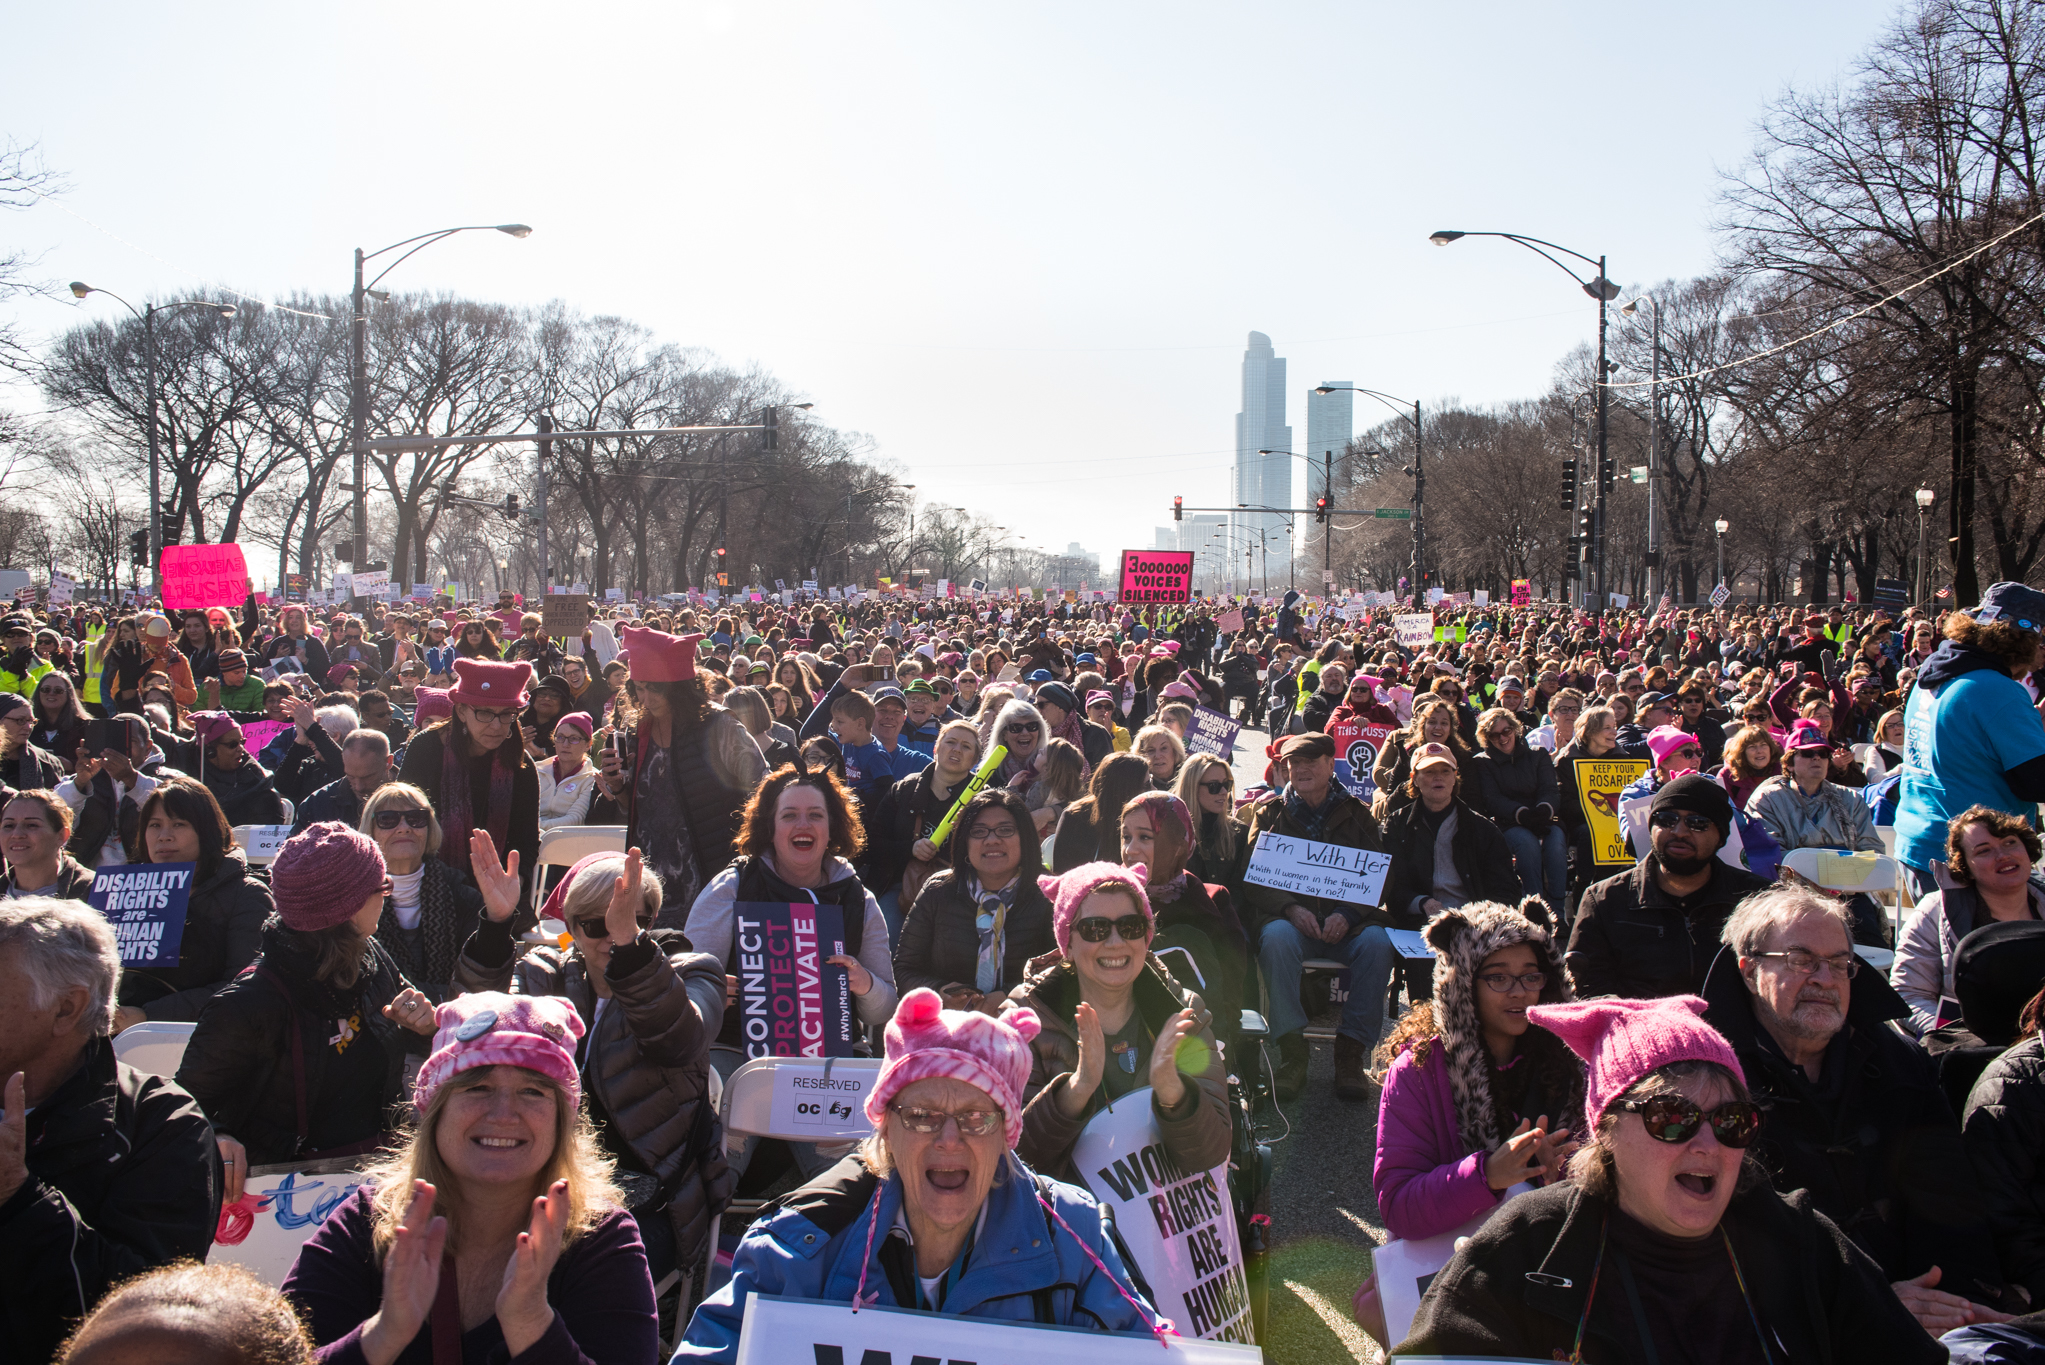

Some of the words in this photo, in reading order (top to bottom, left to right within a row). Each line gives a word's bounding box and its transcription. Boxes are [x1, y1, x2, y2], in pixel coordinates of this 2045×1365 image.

[369, 578, 389, 588] LOVE
[1134, 575, 1182, 588] VOICES
[163, 579, 246, 604] RESPECT
[1124, 589, 1185, 601] SILENCED
[555, 602, 579, 611] FREE
[545, 618, 584, 627] OPPRESSED
[1397, 615, 1430, 626] AMERICA
[1396, 628, 1435, 643] RAINBOW
[1193, 708, 1240, 732] DISABILITY
[1197, 719, 1229, 738] RIGHTS
[242, 721, 270, 739] ands
[1204, 731, 1217, 740] are
[1337, 725, 1359, 736] THIS
[1361, 726, 1391, 739] PUSSY
[1191, 732, 1224, 752] HUMAN
[1593, 764, 1610, 774] KEEP
[1614, 764, 1636, 774] YOUR
[1257, 833, 1294, 856] I'm
[1307, 842, 1346, 867] With
[1354, 851, 1390, 874] Her
[94, 870, 191, 893] DISABILITY
[1247, 872, 1266, 884] how
[1267, 877, 1293, 889] could
[1305, 885, 1321, 896] say
[1281, 871, 1309, 881] women
[1312, 875, 1321, 883] in
[1323, 875, 1338, 886] the
[105, 889, 170, 911] RIGHTS
[121, 910, 147, 922] are
[114, 921, 166, 942] UMAN
[738, 915, 770, 1061] CONNECT
[766, 919, 797, 1058] PROTECT
[794, 918, 822, 1059] ACTIVATE
[837, 974, 850, 1042] #WhyIMarch
[797, 1103, 821, 1115] OC
[1147, 1173, 1223, 1240] RIGHTS
[1186, 1223, 1229, 1280] ARE
[1182, 1262, 1249, 1338] HUMAN
